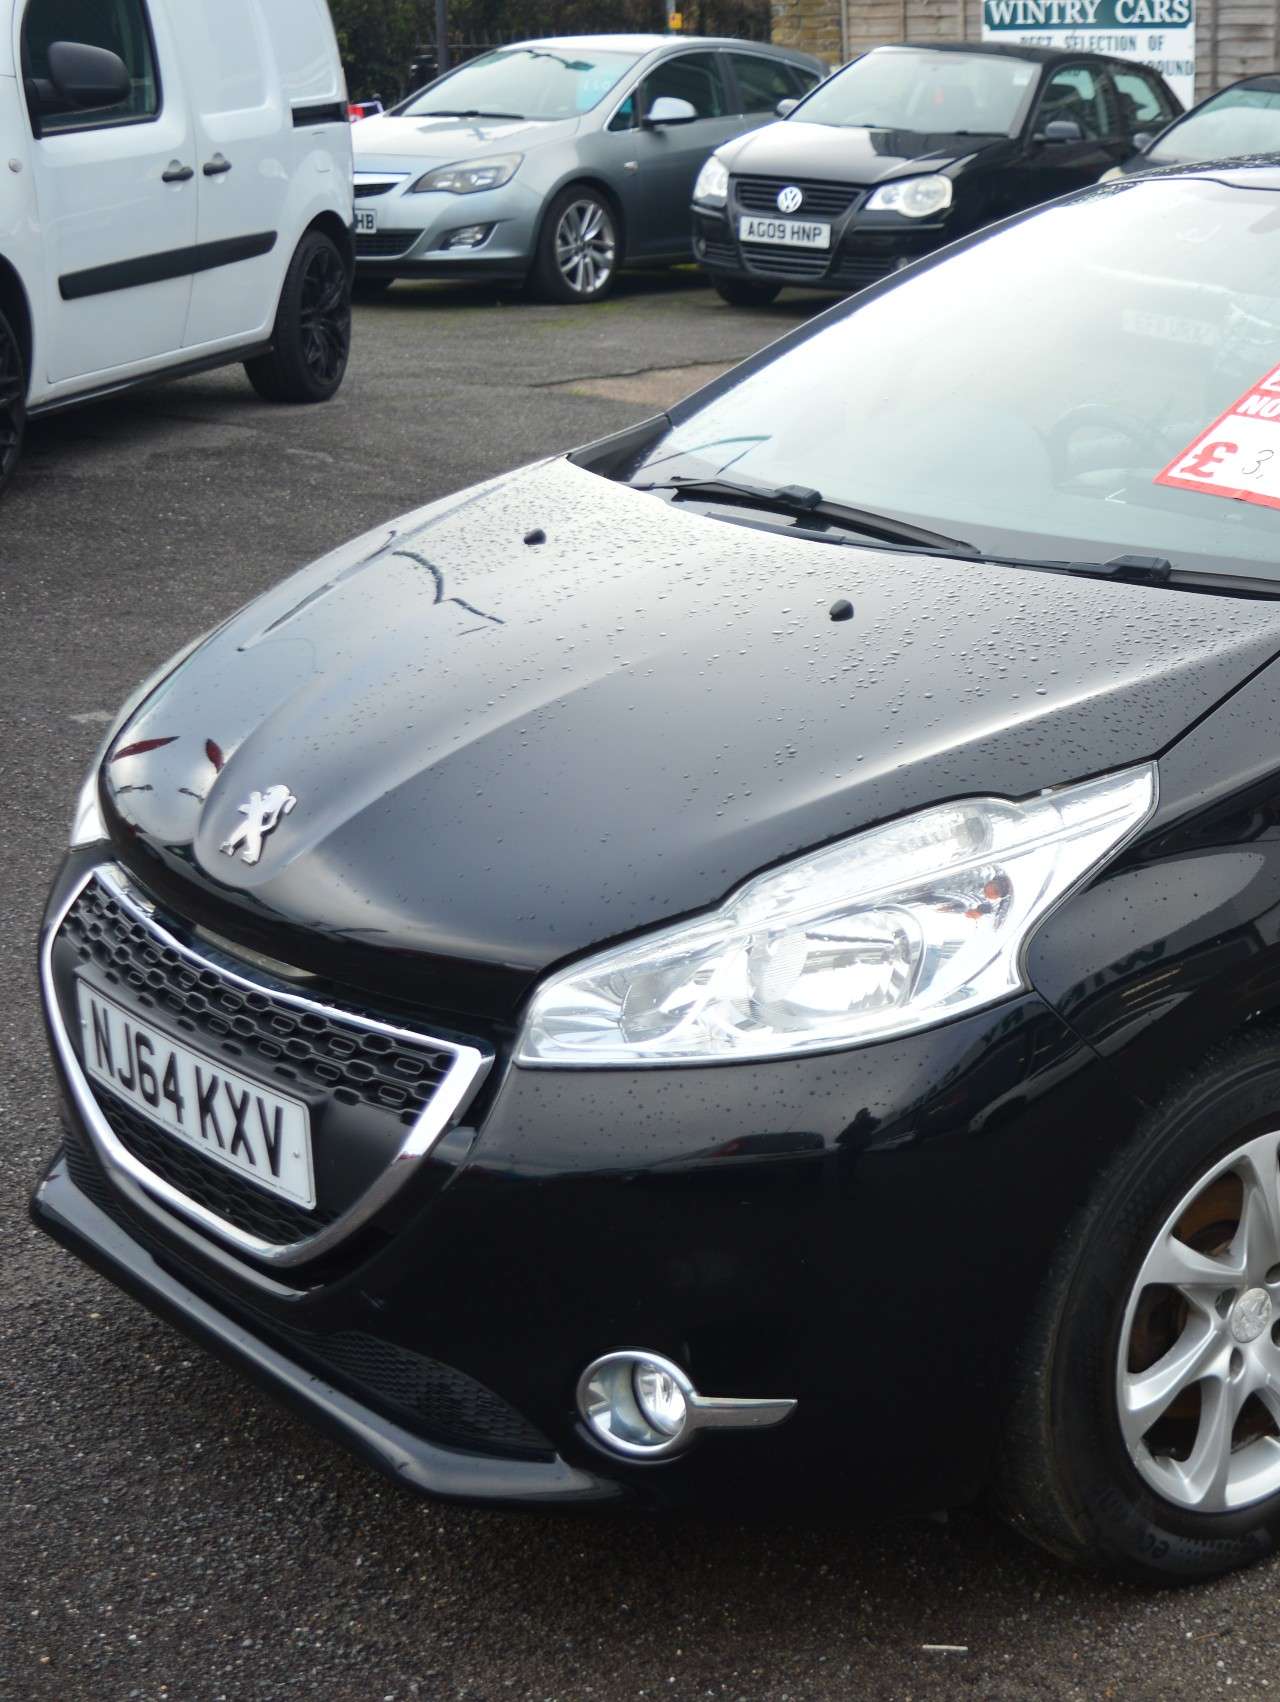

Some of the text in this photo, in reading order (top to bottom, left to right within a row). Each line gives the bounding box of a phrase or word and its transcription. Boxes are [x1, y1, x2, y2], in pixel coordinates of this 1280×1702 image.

[989, 0, 1190, 24] WINTRY CARS
[1065, 35, 1136, 51] SELECTION
[1148, 35, 1164, 51] OF
[748, 221, 822, 242] AG09 HNP
[1180, 441, 1239, 478] £
[91, 999, 284, 1178] NJ64 KXV
